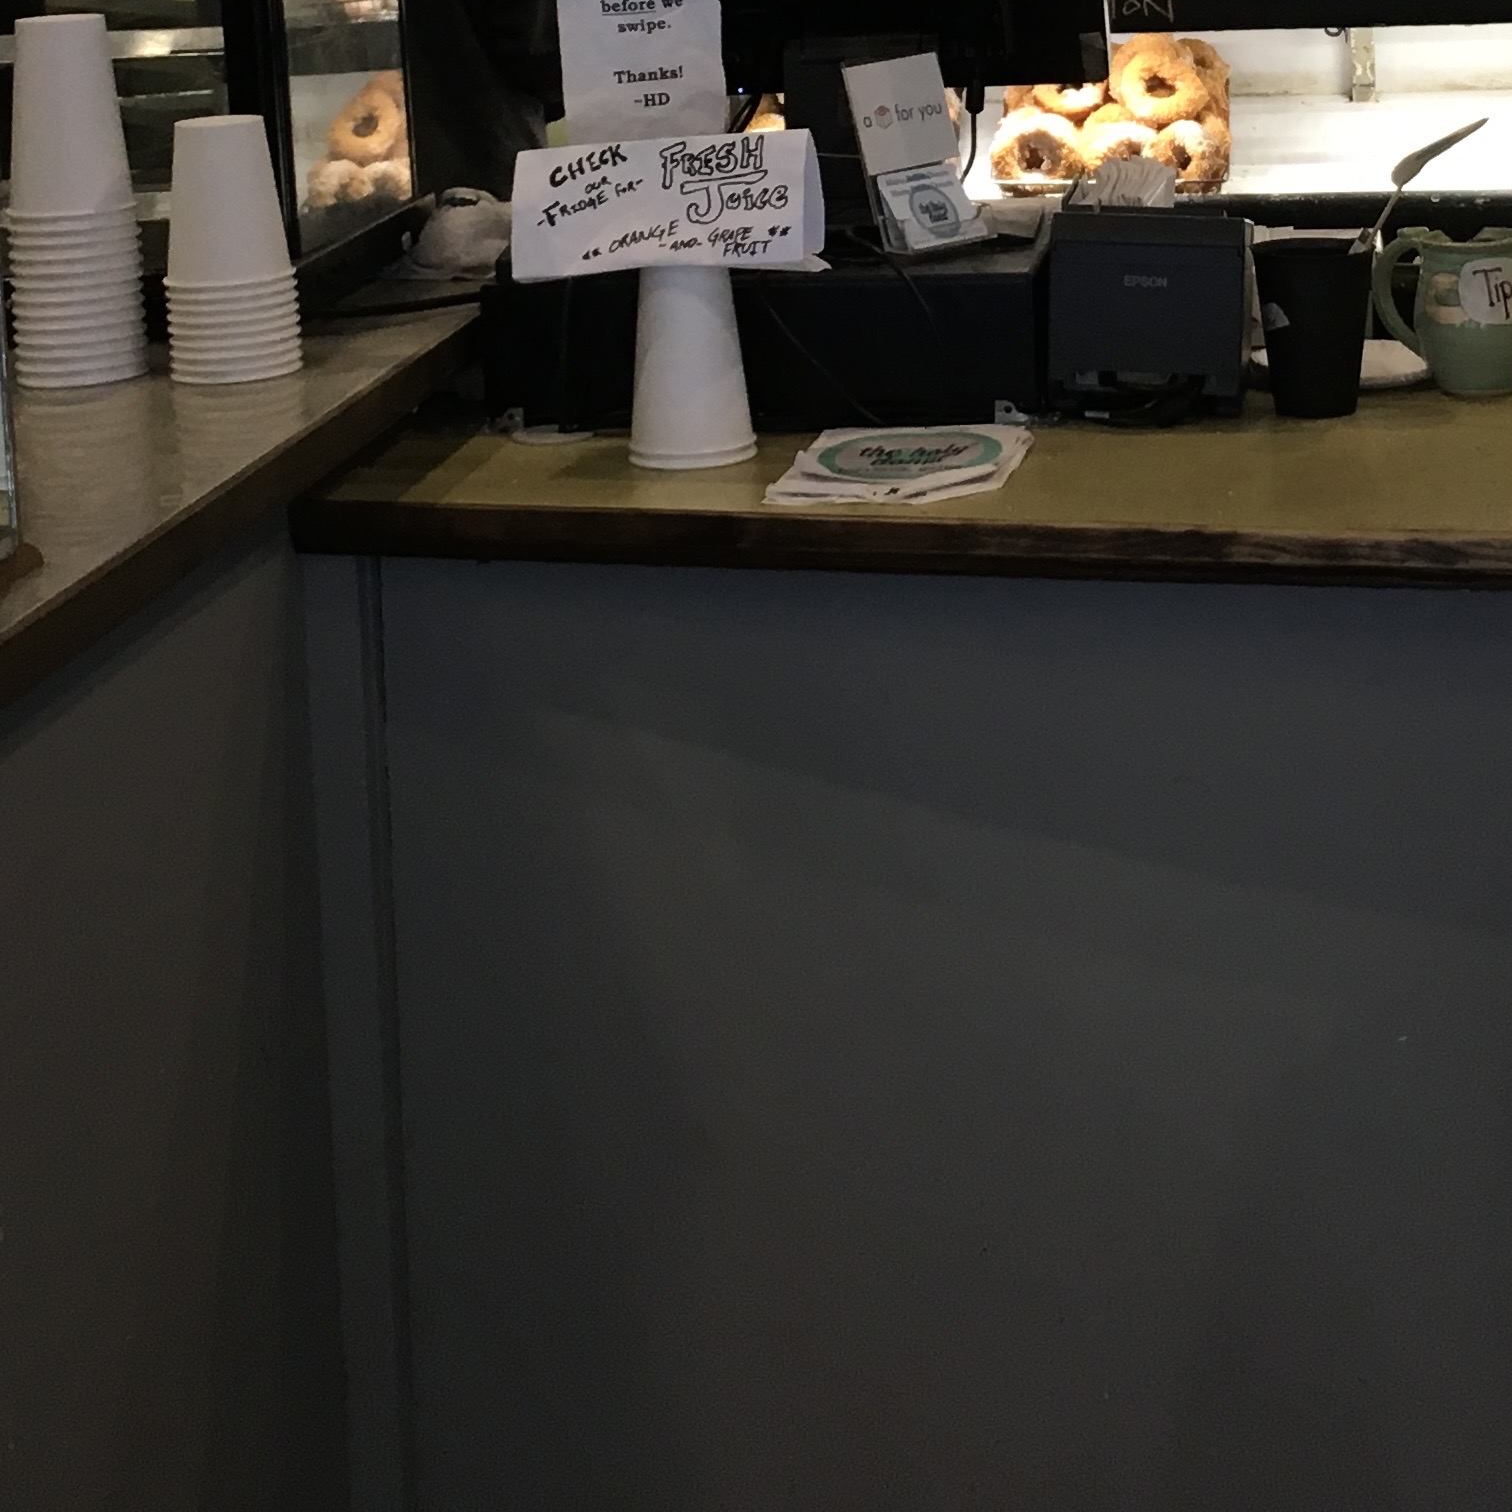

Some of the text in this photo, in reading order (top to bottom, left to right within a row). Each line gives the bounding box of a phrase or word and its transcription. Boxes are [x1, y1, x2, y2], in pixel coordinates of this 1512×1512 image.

[617, 18, 672, 35] swipe.
[613, 65, 685, 85] Thanks!
[862, 100, 944, 129] a for you
[549, 143, 629, 189] CHECK
[658, 134, 766, 190] FRESH
[584, 176, 613, 195] OUR
[608, 219, 681, 254] ORANGE
[707, 226, 755, 248] GRAPE
[722, 238, 774, 259] FRUIT
[1123, 274, 1169, 288] EPSON
